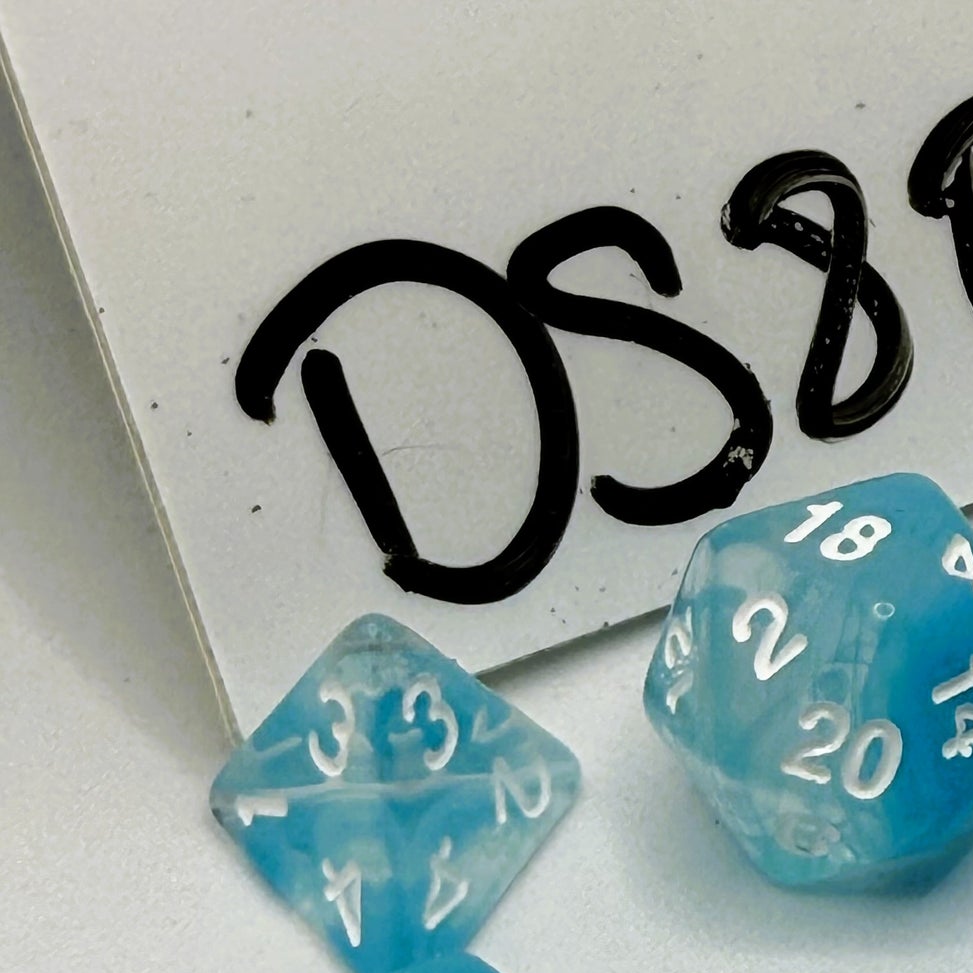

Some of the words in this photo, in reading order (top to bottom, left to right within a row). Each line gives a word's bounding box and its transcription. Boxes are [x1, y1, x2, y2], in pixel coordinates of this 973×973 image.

[784, 501, 893, 561] 18
[732, 592, 809, 681] 2
[309, 677, 355, 777] 3
[403, 672, 459, 770] 3
[781, 702, 903, 800] 20
[236, 796, 288, 826] 1
[492, 754, 552, 824] 2
[322, 858, 363, 947] 4
[423, 836, 470, 930] 4
